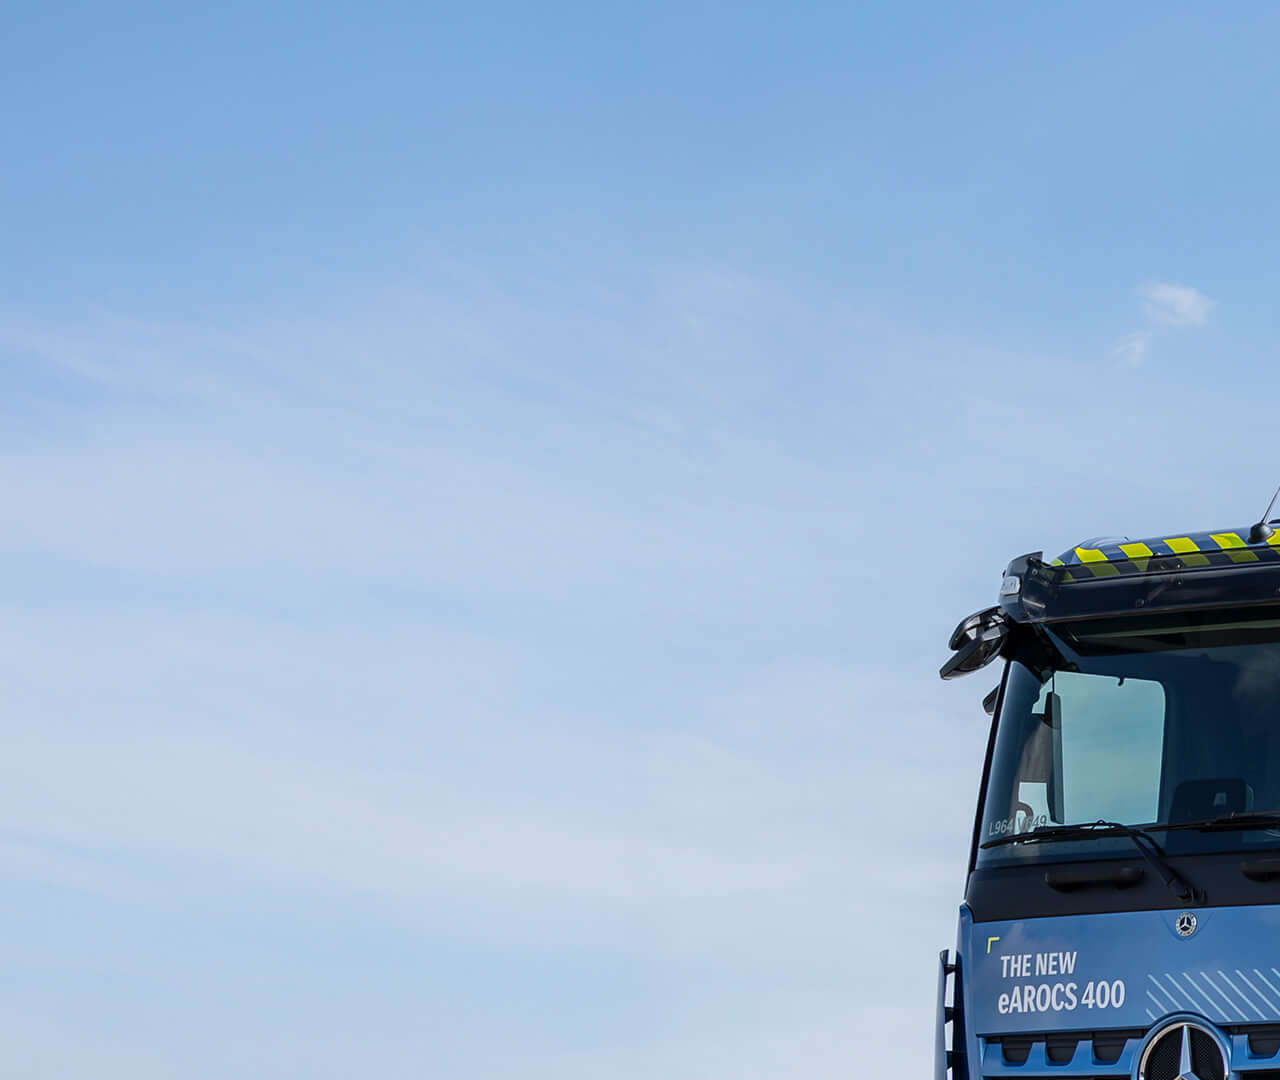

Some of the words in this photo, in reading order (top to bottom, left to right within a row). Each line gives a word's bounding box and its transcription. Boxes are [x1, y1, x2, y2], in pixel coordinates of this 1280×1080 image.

[1000, 953, 1033, 979] THE
[1035, 951, 1078, 977] NEW
[998, 981, 1078, 1015] eAROCS
[1081, 979, 1126, 1009] 400
